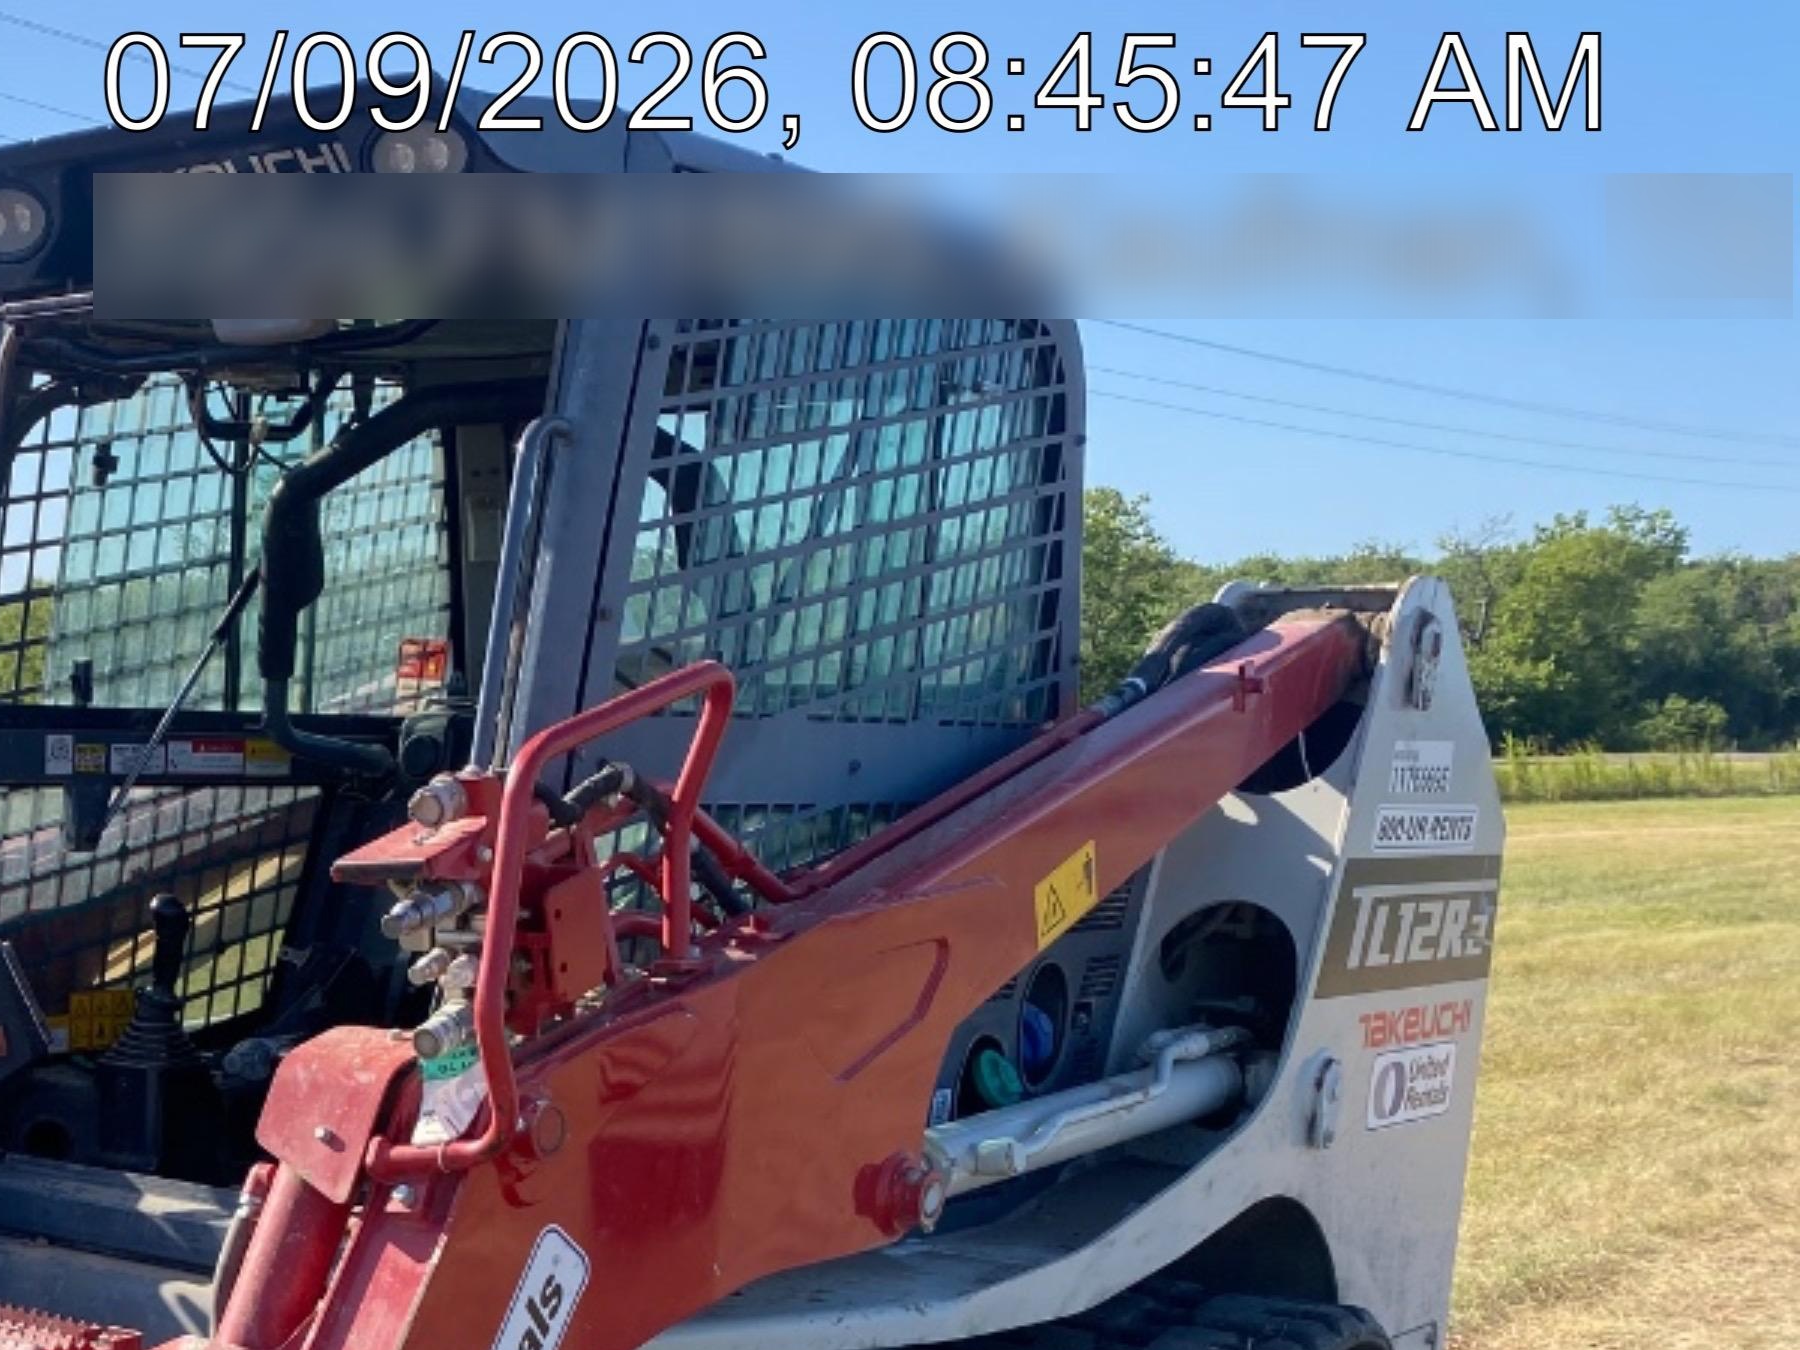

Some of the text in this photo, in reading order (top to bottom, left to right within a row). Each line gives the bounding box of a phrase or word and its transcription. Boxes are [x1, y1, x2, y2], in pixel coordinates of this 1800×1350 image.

[1358, 998, 1472, 1050] TAKEUCHI
[1408, 1053, 1450, 1083] United
[1404, 1080, 1450, 1111] Rentals
